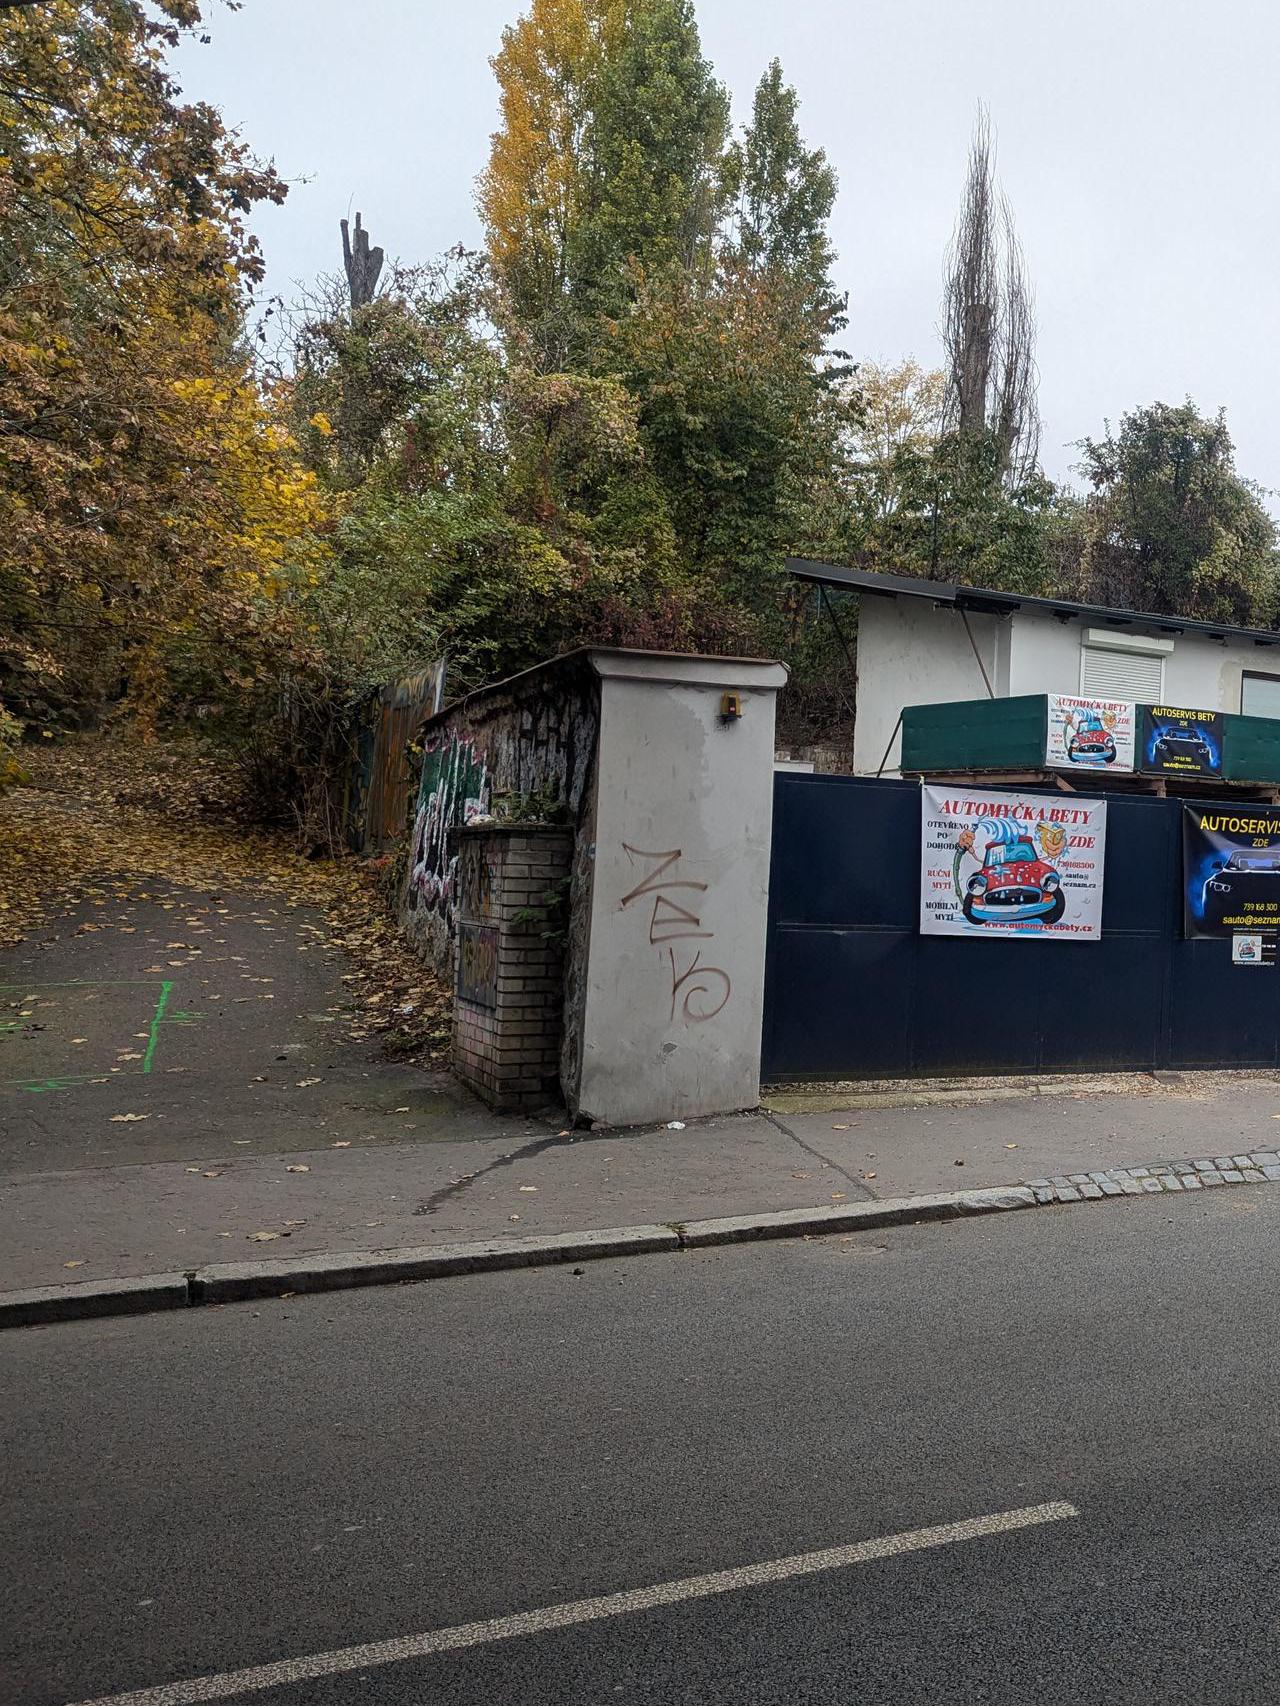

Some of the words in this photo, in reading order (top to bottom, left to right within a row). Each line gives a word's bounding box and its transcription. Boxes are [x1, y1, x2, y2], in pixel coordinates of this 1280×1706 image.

[1152, 707, 1196, 720] AUTOSERVIS
[1197, 712, 1216, 722] BETY
[939, 800, 1045, 822] AUTOMYČKA
[1047, 808, 1093, 825] BETY
[927, 820, 969, 830] OTEVŘENO
[1068, 835, 1096, 849] ZDE
[1252, 838, 1270, 848] ZDE
[927, 869, 951, 878] RUČNÍ
[931, 881, 952, 890] MYTÍ
[925, 901, 959, 910] MOBILNÍ
[934, 912, 954, 921] MYTÍ
[983, 921, 1093, 932] www.automyckabety.cz
